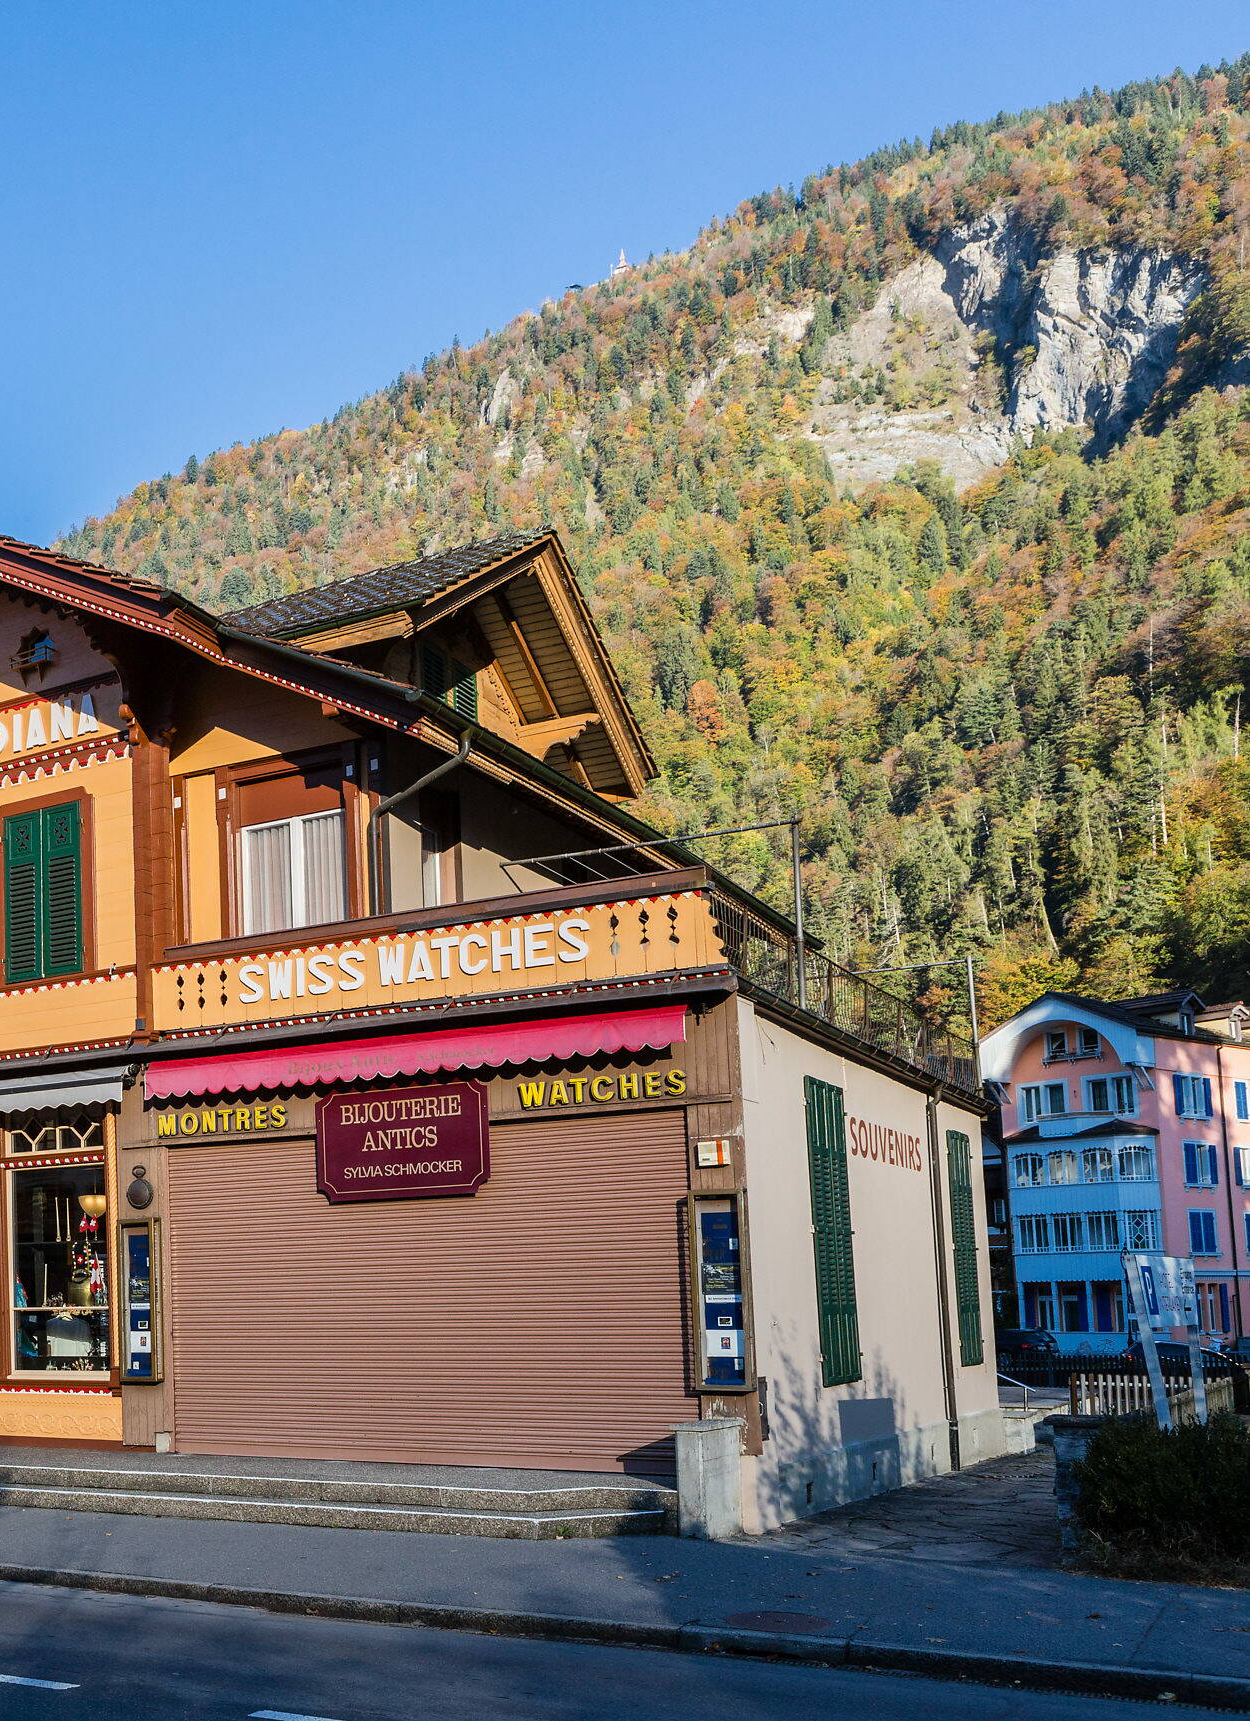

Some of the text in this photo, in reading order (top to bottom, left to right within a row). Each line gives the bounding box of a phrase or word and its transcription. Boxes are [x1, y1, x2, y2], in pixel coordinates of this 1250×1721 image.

[239, 918, 591, 1004] SWISS WATCHES
[518, 1069, 687, 1109] WATCHES
[158, 1104, 287, 1138] MONTRES
[340, 1095, 462, 1126] BIJOUTERIE
[361, 1126, 439, 1152] ANTICS
[849, 1116, 922, 1172] SOUVENIRS
[344, 1159, 463, 1180] SYLVIA SCHMOCKER
